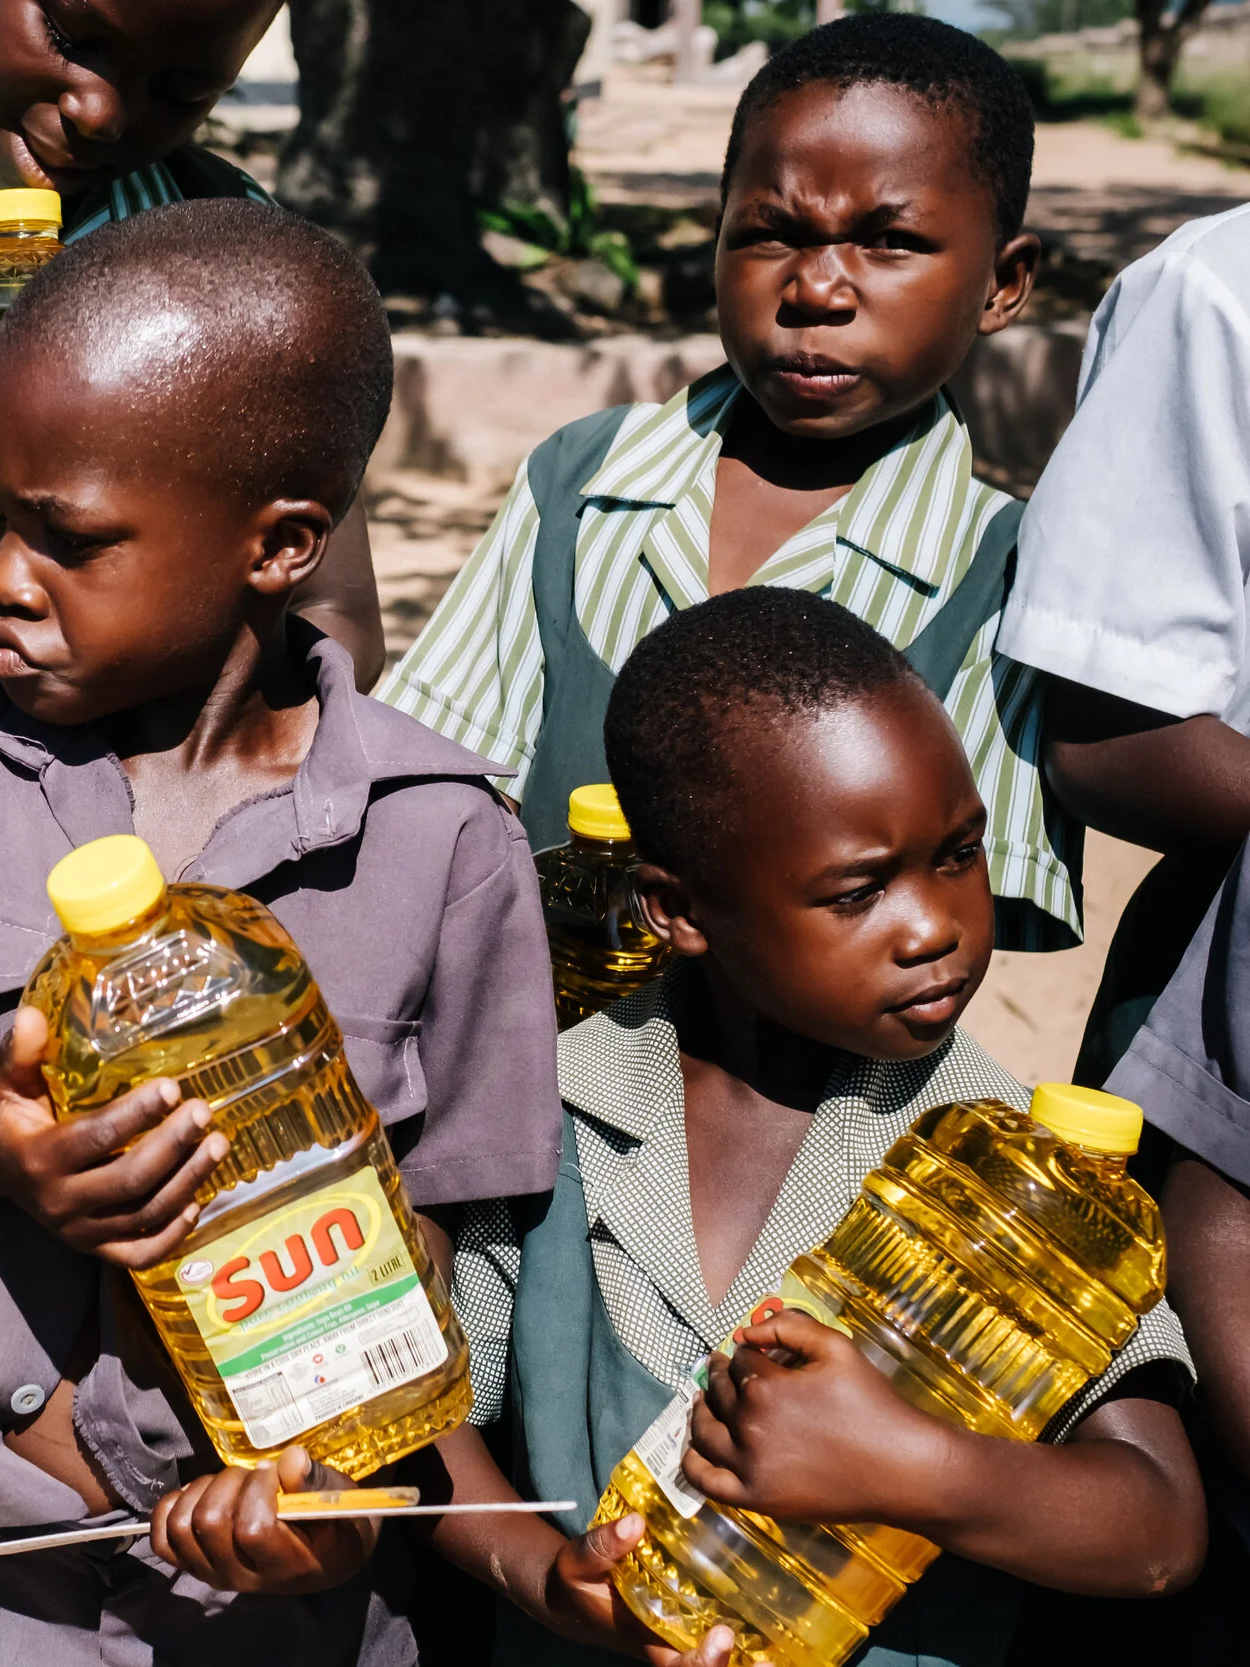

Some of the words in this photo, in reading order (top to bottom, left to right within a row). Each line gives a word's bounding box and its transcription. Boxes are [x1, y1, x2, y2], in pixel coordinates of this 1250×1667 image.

[371, 1269, 379, 1281] 2
[379, 1256, 403, 1277] LITRE
[239, 1309, 273, 1332] pure
[277, 1279, 337, 1312] cooking
[341, 1266, 359, 1281] oil
[290, 1349, 303, 1360] DRY
[323, 1331, 339, 1343] AWAY
[339, 1323, 356, 1336] FROM
[356, 1313, 376, 1327] DIRECT
[376, 1300, 405, 1318] SUNLIGHT
